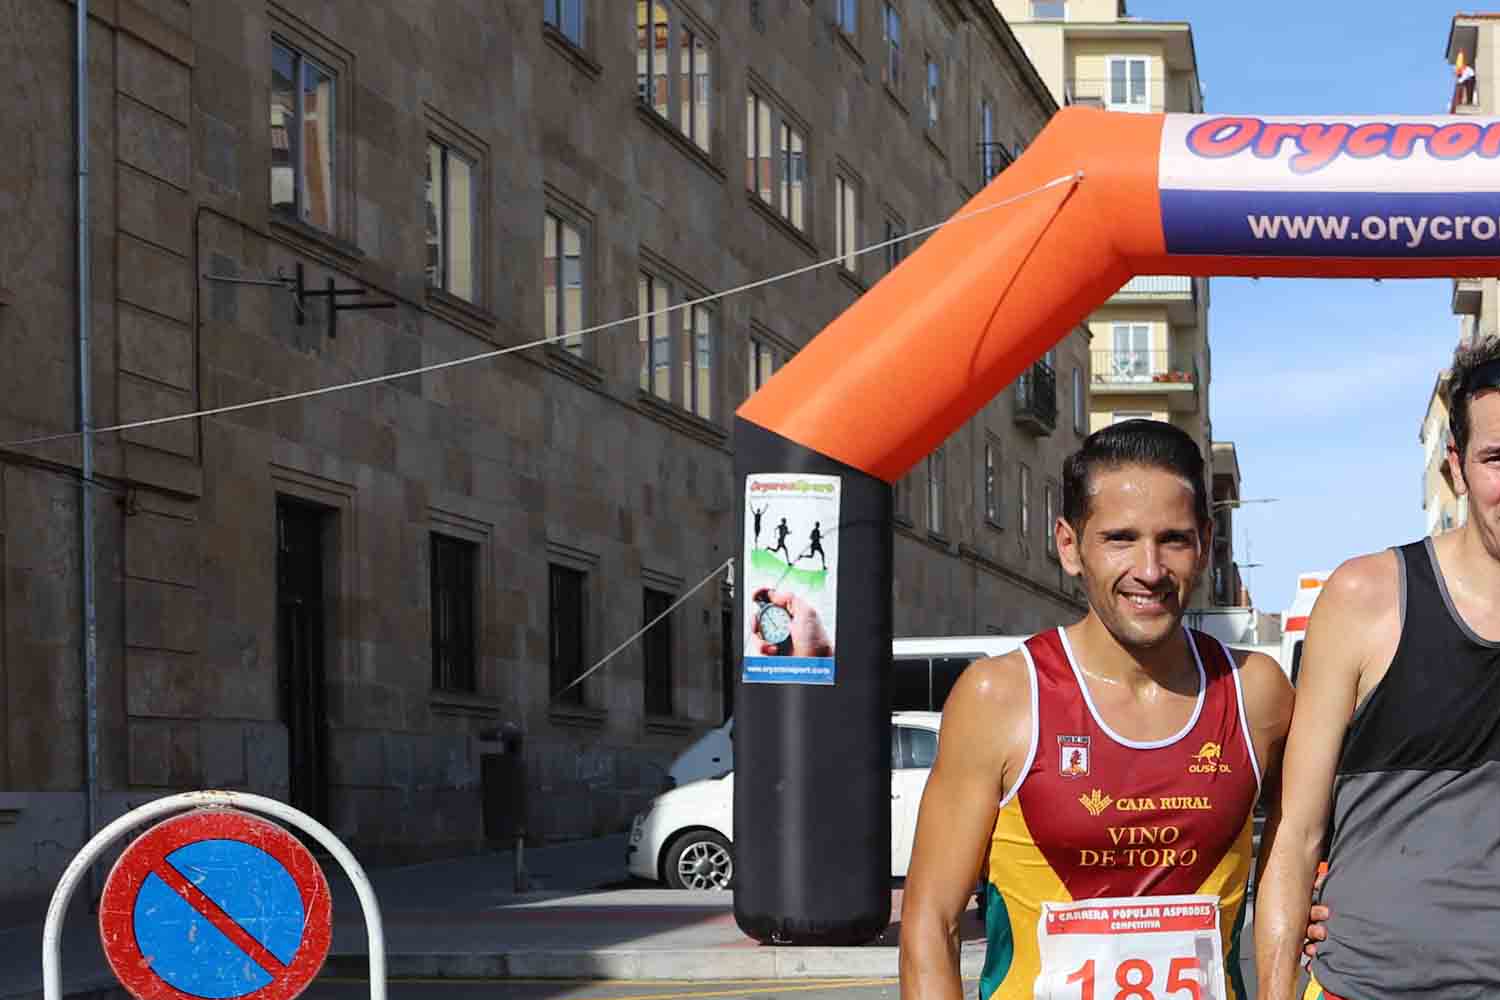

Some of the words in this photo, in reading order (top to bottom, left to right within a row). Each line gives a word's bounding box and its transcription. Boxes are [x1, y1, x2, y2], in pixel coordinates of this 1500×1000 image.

[1116, 797, 1156, 811] CAJA
[1160, 796, 1212, 810] RURAL
[1107, 825, 1180, 845] VINO
[1079, 848, 1117, 867] DE
[1123, 848, 1198, 868] TORO
[1058, 911, 1109, 921] CARRERA
[1112, 908, 1160, 919] POPULAR
[1163, 905, 1210, 917] ASPRODES
